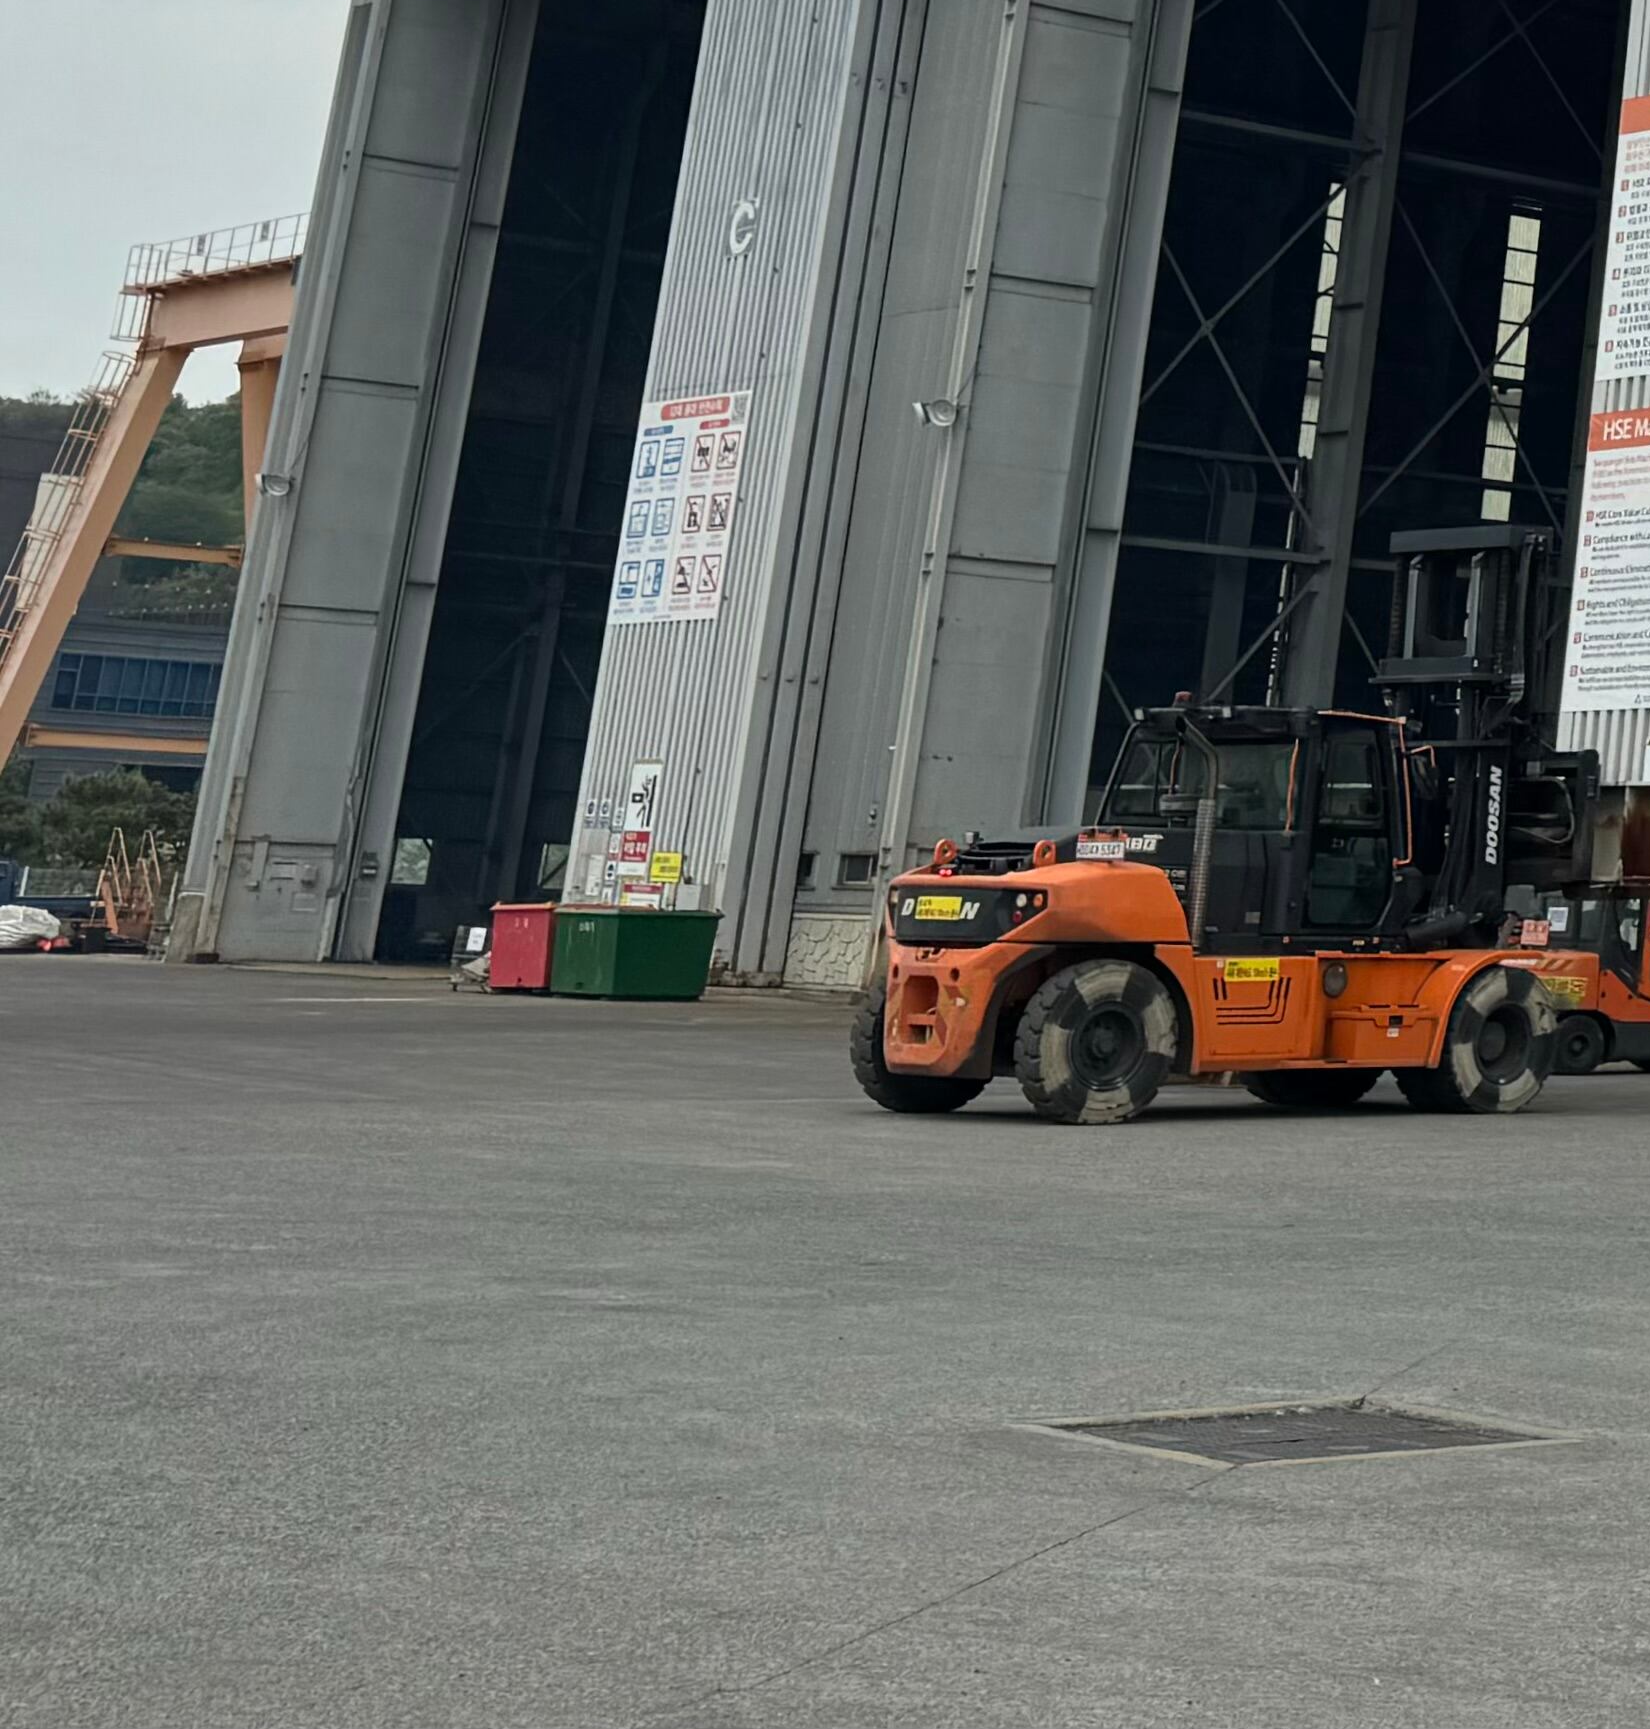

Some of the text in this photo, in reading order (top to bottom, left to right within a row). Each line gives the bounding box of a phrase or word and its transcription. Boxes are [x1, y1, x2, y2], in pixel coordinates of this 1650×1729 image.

[729, 200, 755, 255] C
[1602, 417, 1633, 441] HSE
[1485, 764, 1502, 865] DOOSAN
